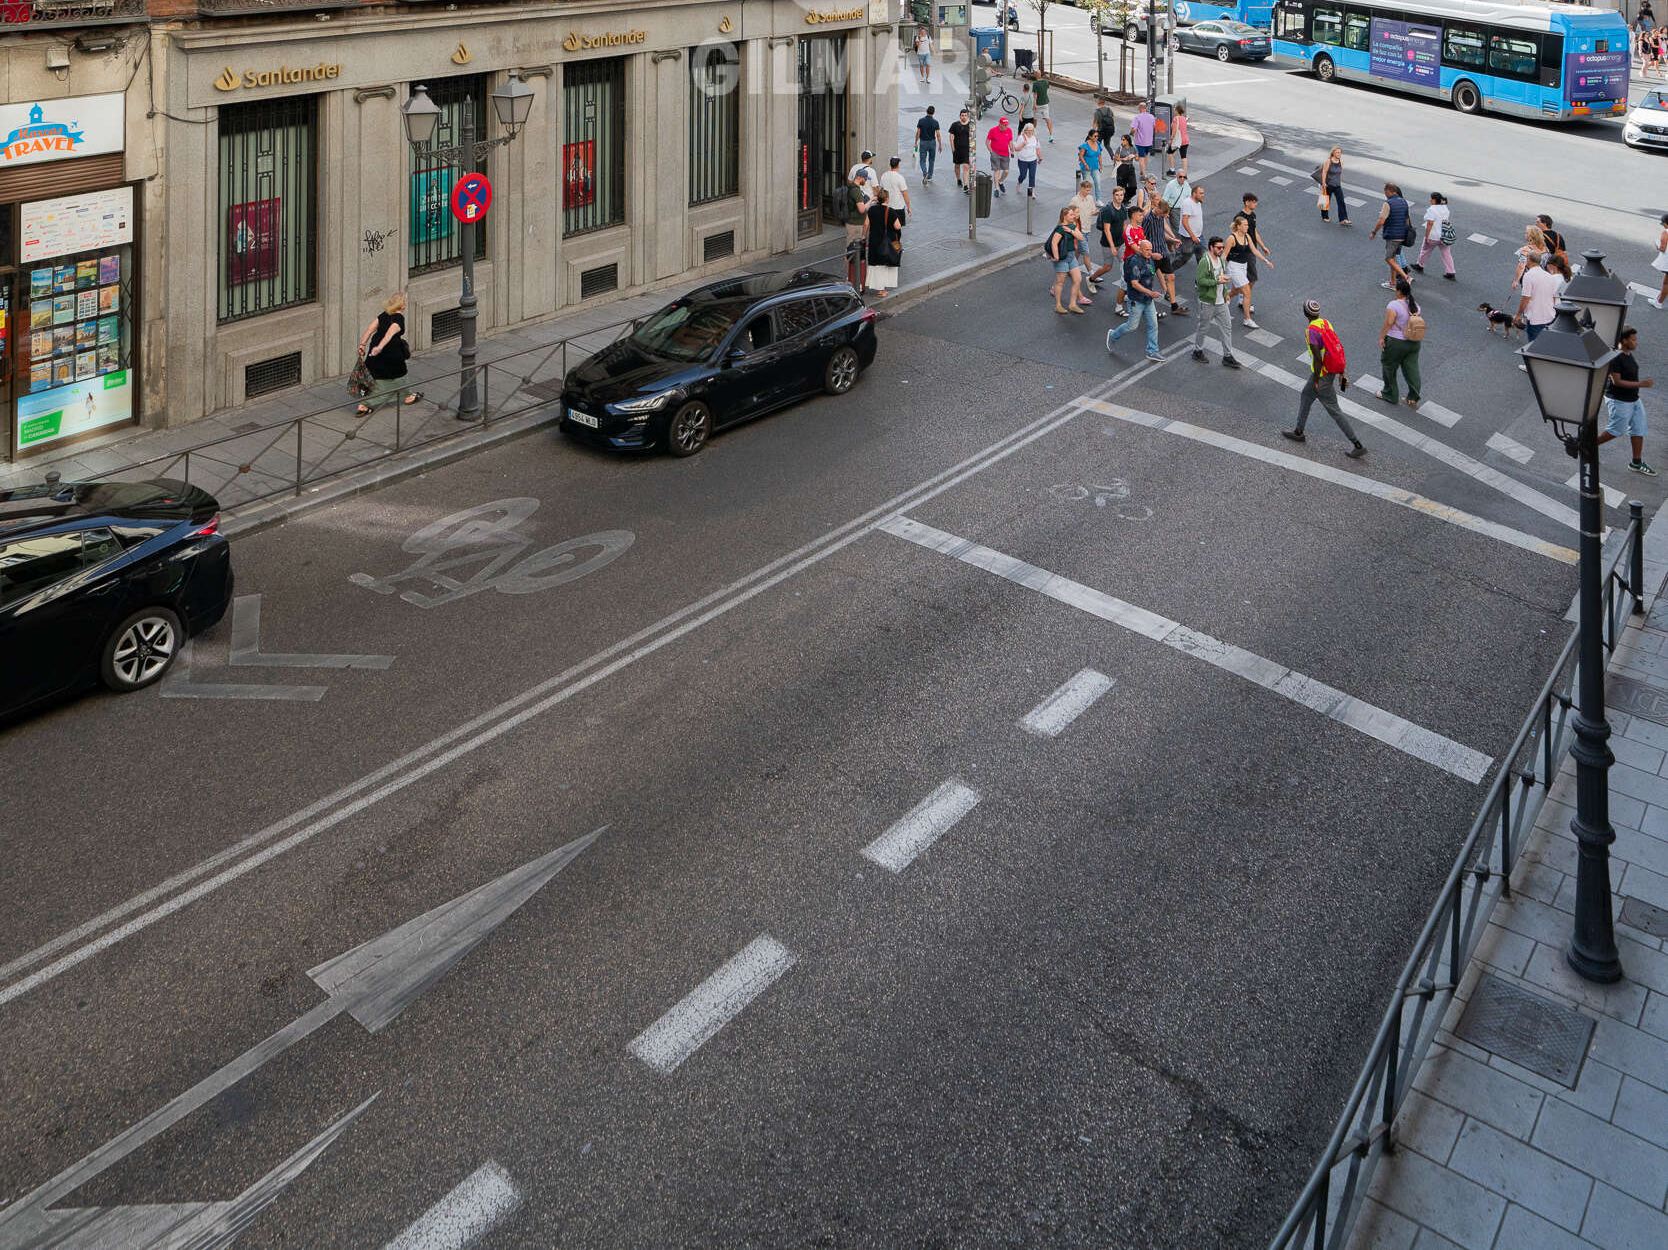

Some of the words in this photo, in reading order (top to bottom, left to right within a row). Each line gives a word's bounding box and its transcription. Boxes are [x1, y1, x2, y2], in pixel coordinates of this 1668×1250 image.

[819, 8, 865, 23] Santander
[582, 29, 647, 49] Santander
[243, 61, 343, 88] Santander
[13, 127, 63, 141] Marcas
[2, 137, 77, 161] TRAVEL
